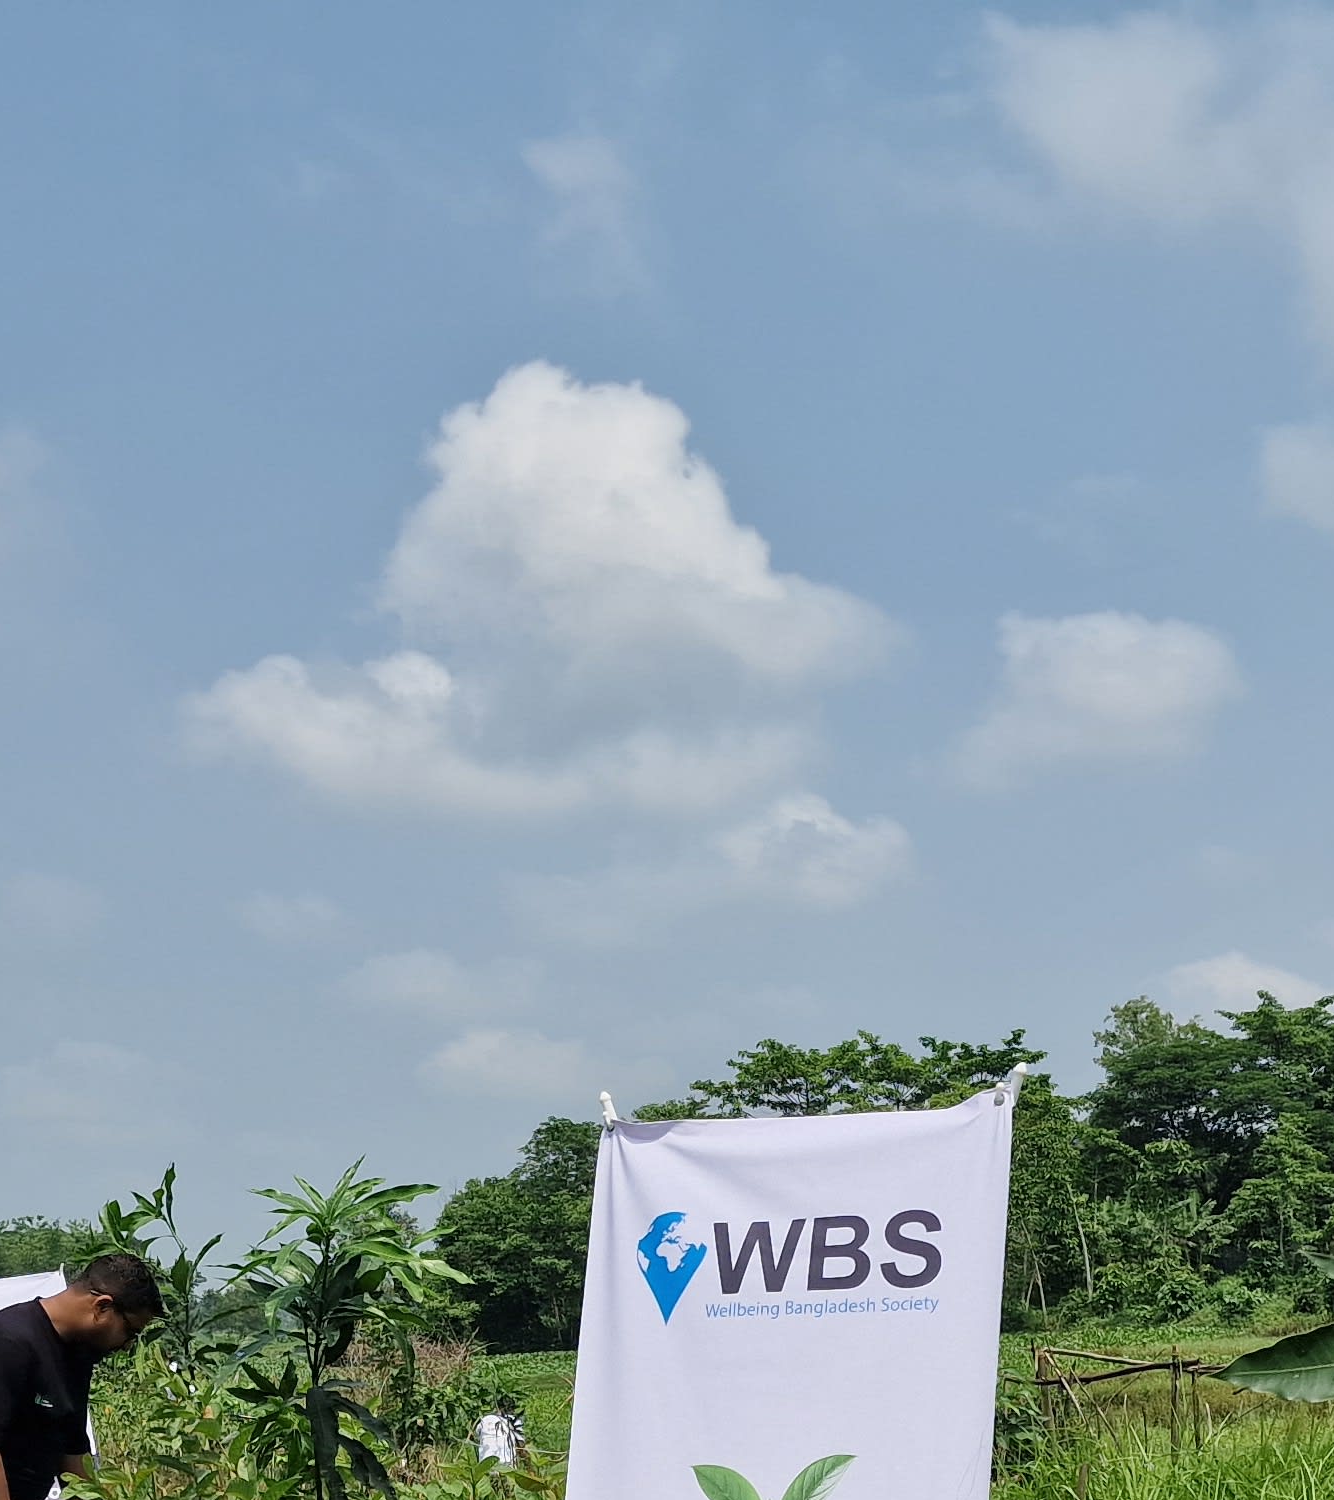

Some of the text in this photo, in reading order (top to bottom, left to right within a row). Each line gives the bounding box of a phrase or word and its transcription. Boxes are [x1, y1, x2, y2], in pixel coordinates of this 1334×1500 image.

[713, 1209, 942, 1295] WBS
[705, 1295, 940, 1320] Wellbeing Bangladesh Society
